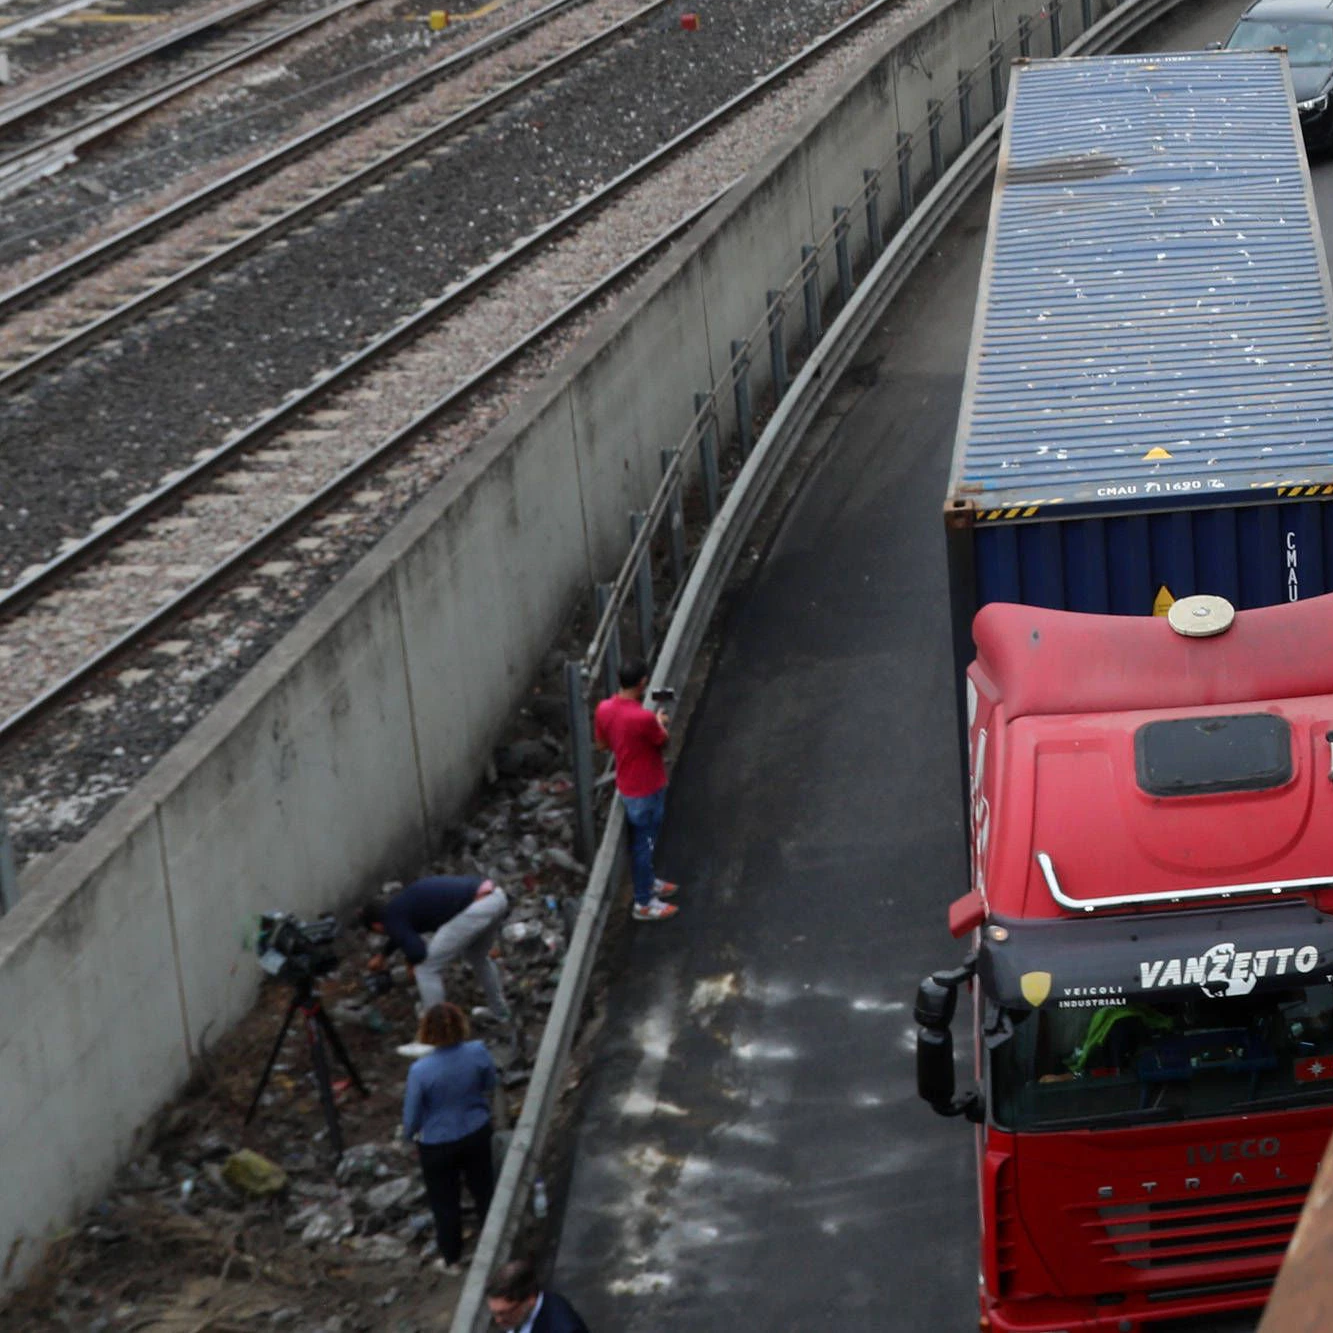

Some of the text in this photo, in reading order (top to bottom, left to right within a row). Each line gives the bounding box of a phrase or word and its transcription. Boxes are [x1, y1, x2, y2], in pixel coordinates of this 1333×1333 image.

[1097, 486, 1137, 496] CMAU
[1286, 532, 1298, 602] CMAU
[1140, 945, 1319, 989] VANZETTO
[1064, 986, 1123, 996] VEICOLI
[1059, 998, 1127, 1008] INDUSTRIALI
[1187, 1137, 1281, 1166] IVECO
